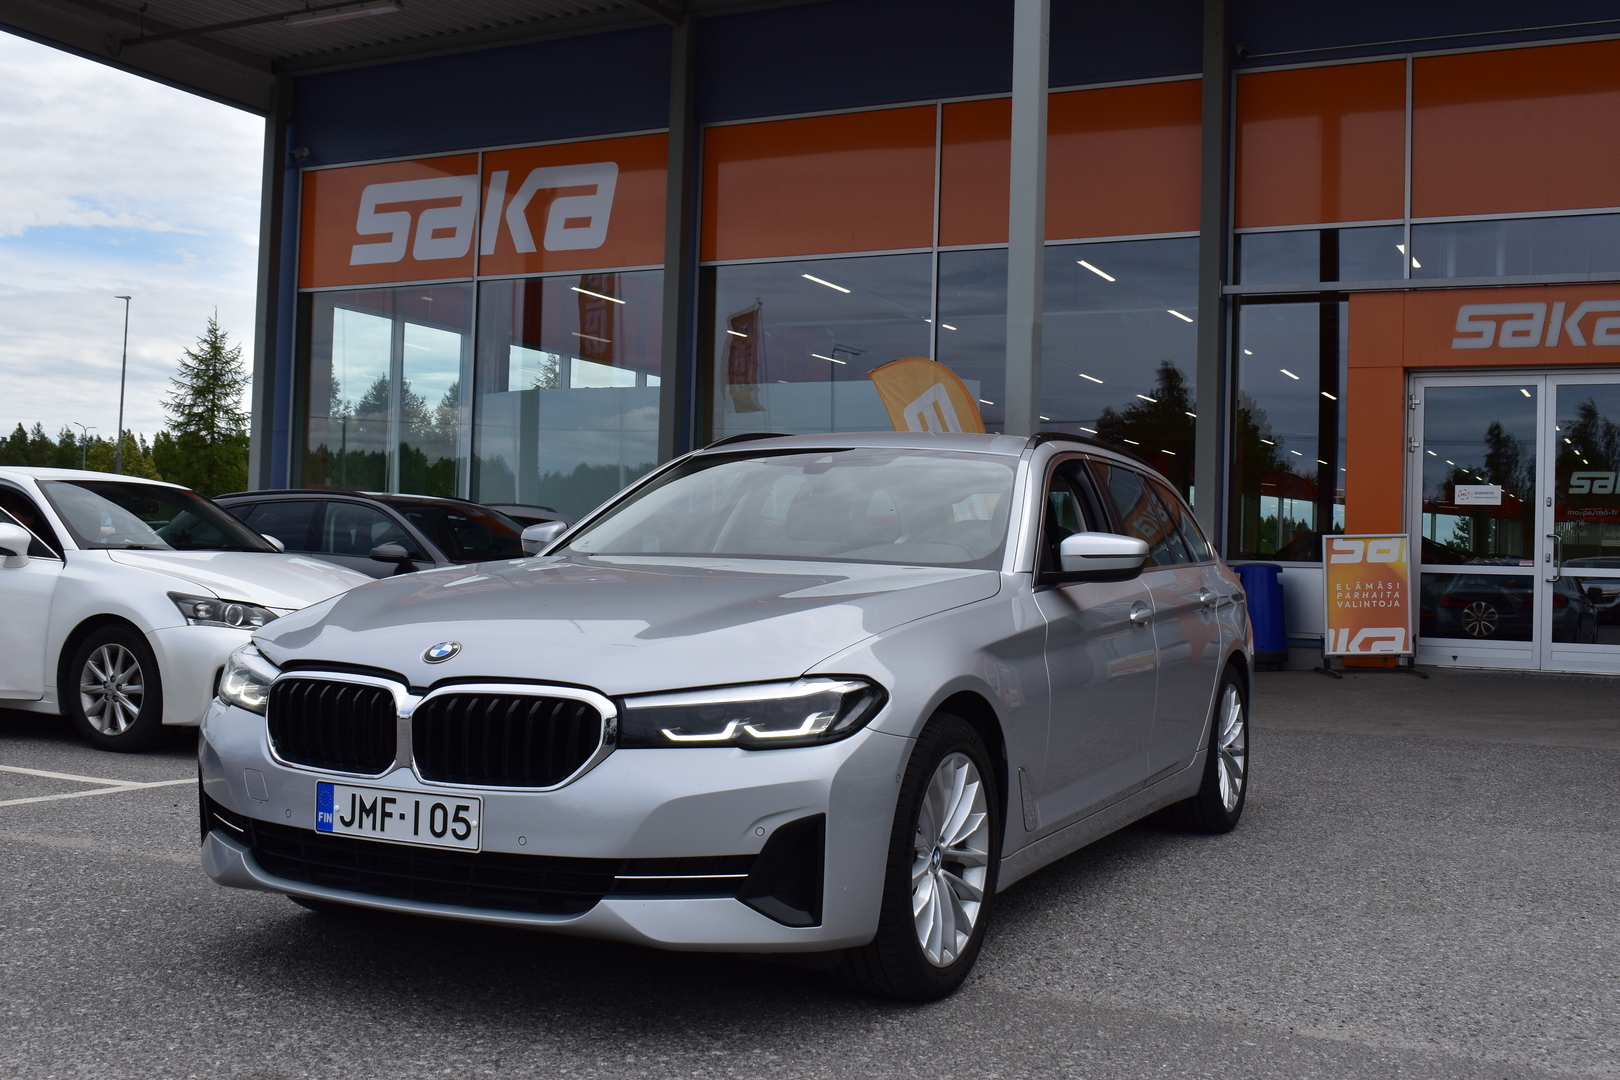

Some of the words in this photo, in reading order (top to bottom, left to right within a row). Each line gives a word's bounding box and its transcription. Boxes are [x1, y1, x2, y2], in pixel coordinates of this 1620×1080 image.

[1336, 581, 1400, 590] ELÄMÄSI
[1336, 591, 1400, 599] PARHAITA
[1336, 600, 1400, 608] VALINTOJA
[318, 812, 332, 824] FIN
[339, 793, 472, 841] JMF-105
